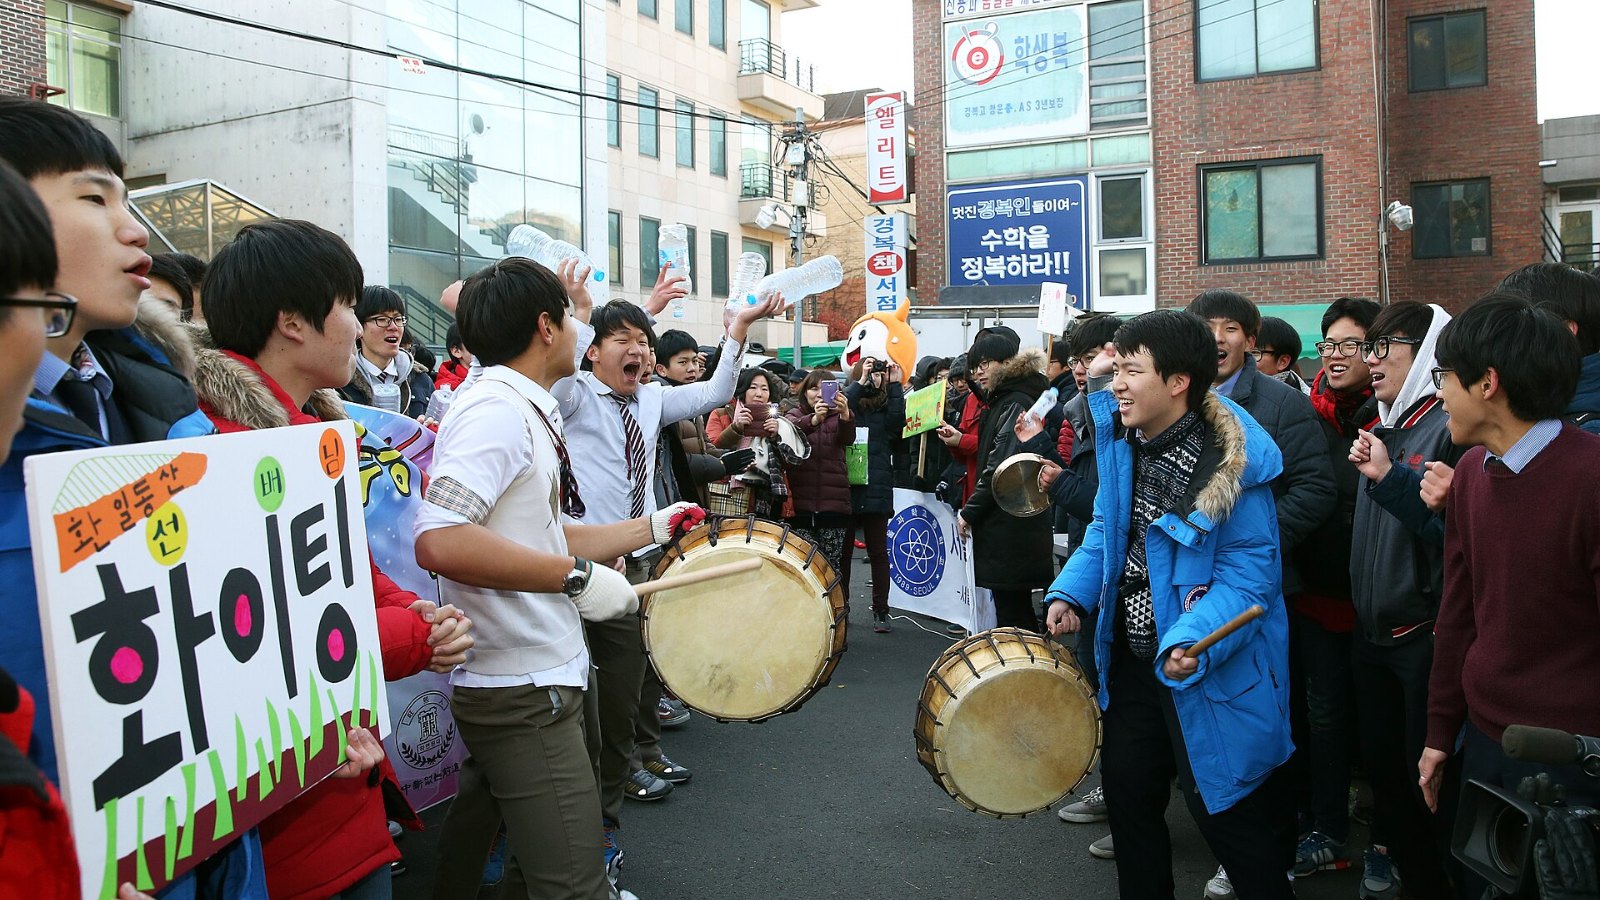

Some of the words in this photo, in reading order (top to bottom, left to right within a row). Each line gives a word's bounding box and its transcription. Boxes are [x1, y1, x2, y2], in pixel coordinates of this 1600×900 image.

[1014, 32, 1069, 74] 학생복
[1019, 101, 1032, 112] AS
[875, 106, 897, 186] 엘리트
[952, 205, 977, 220] 멋진
[980, 224, 1050, 252] 수학을
[960, 251, 1071, 281] 정복하라!!
[70, 474, 358, 812] 화이팅
